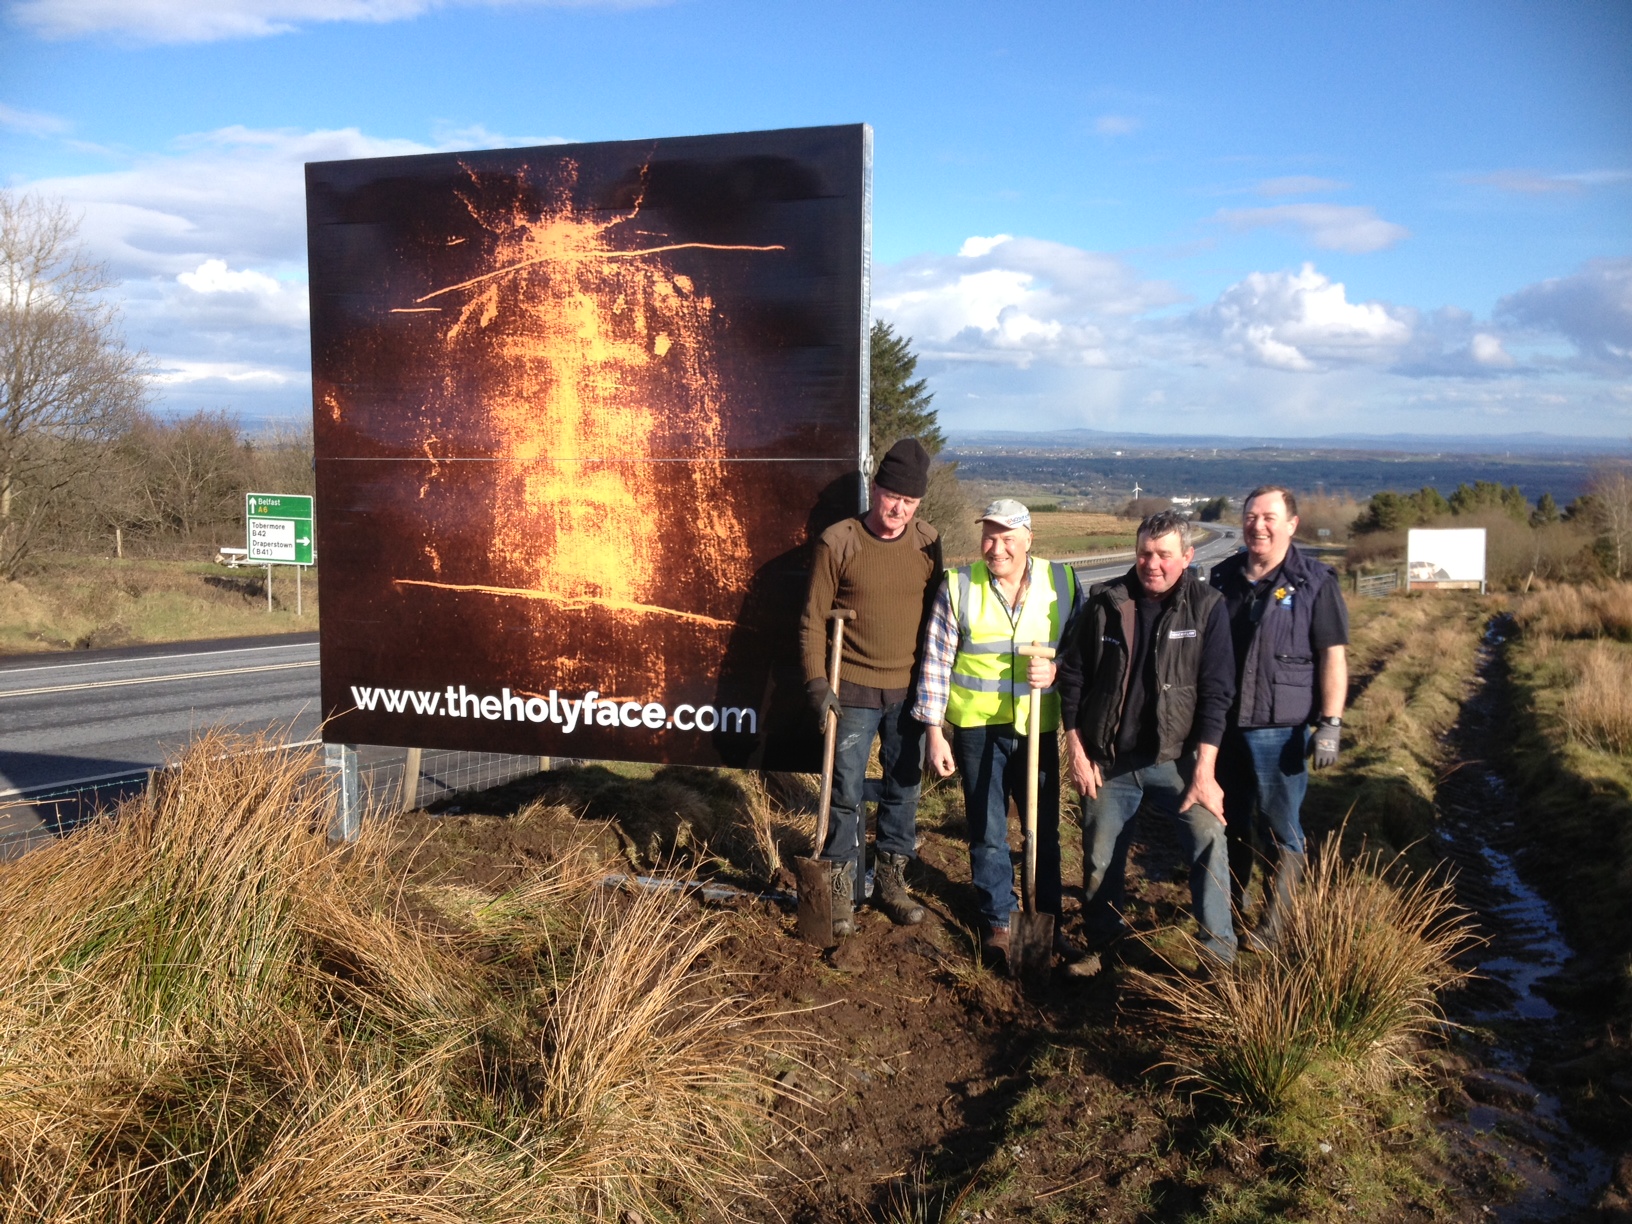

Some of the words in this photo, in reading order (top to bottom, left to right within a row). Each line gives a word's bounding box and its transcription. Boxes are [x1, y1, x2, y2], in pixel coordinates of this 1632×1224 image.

[258, 498, 281, 506] Belfast
[252, 522, 285, 530] Tobermore
[252, 540, 293, 548] Draperstown
[252, 548, 273, 556] (B41)
[350, 685, 757, 734] www.theholyface.com
